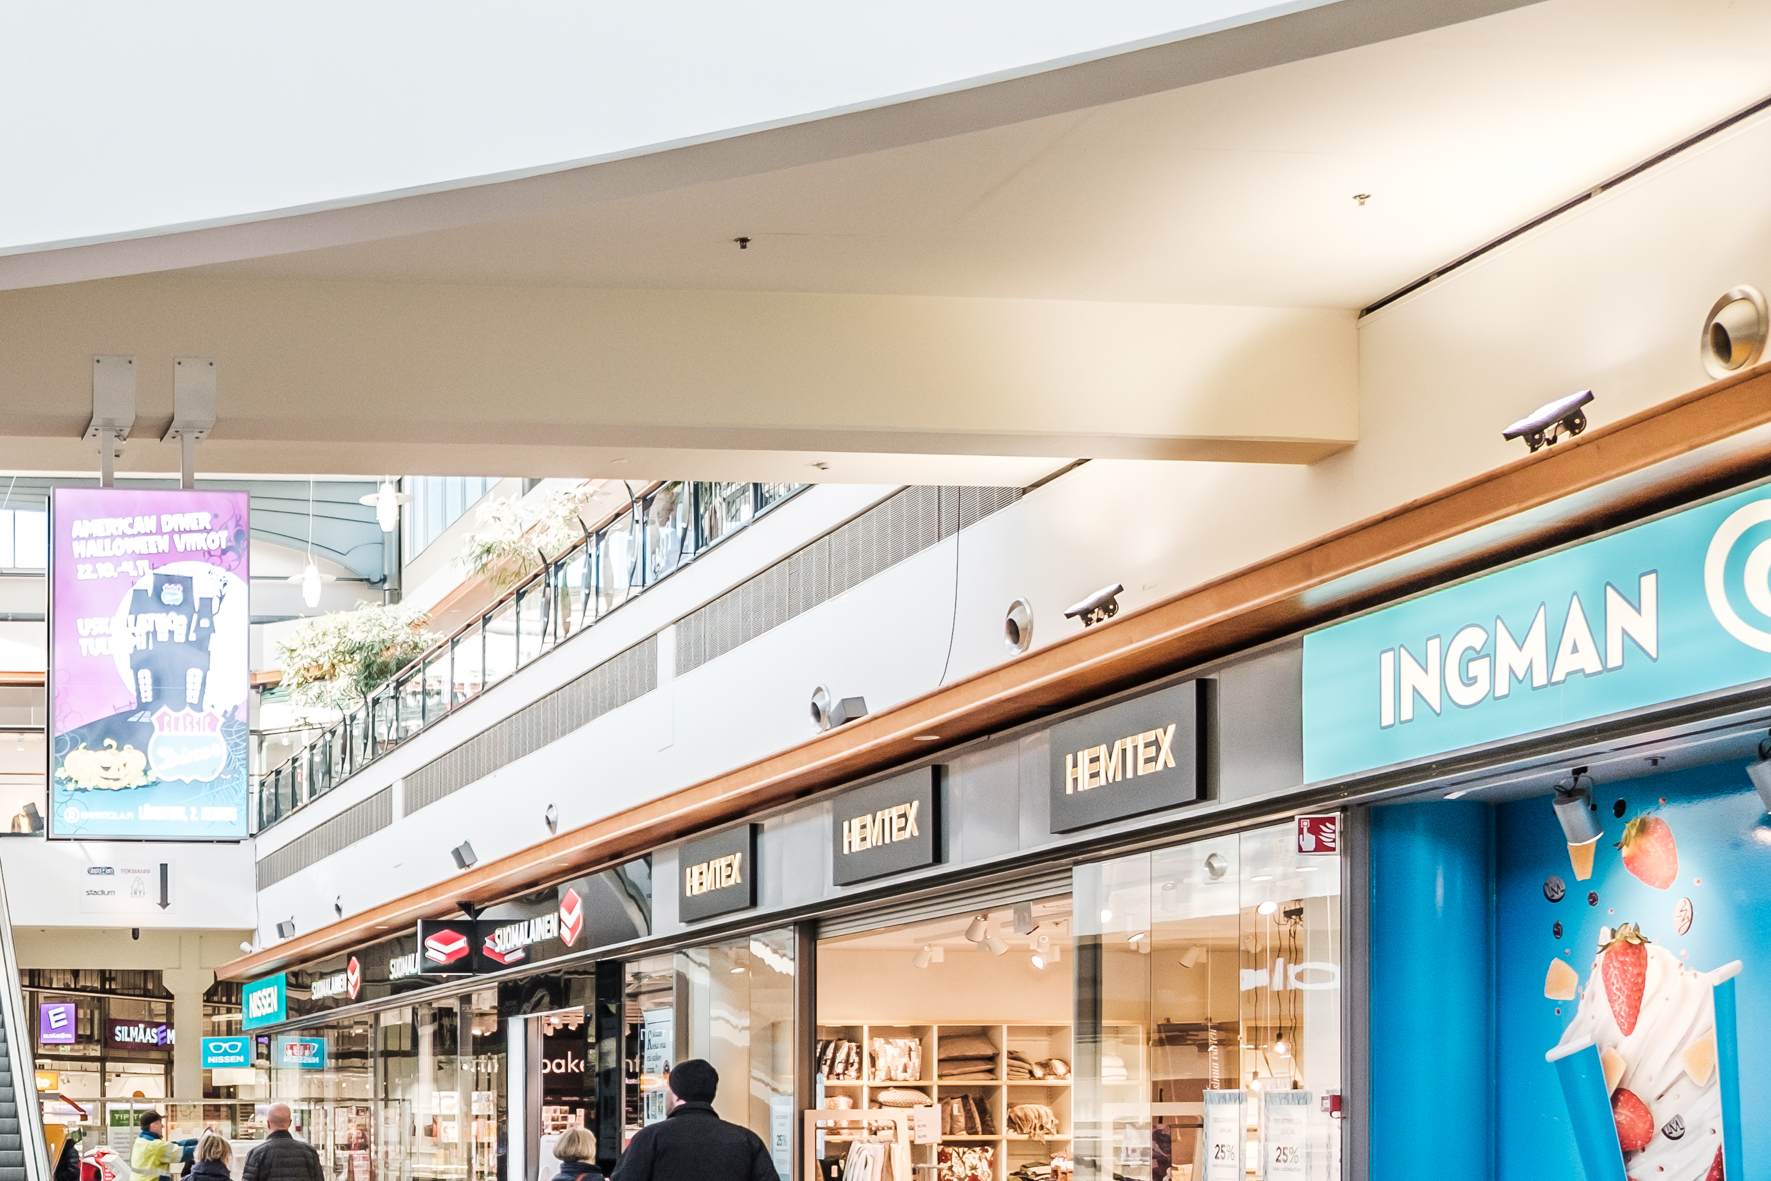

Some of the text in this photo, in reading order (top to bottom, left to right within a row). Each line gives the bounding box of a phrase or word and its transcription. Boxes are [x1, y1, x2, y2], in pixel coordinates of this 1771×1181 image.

[72, 512, 212, 538] AMERICAN DINER
[72, 530, 228, 559] HALLOWEEN VIIKOT
[1380, 568, 1659, 730] INGMAN
[157, 743, 222, 770] Diner
[1064, 723, 1176, 795] HEMTEX
[842, 800, 919, 855] HEMTEX
[685, 852, 742, 897] HEMTEX
[494, 912, 559, 953] SUOMALAINEN
[389, 952, 418, 980] SUOMALA
[249, 985, 278, 1018] NISSEN
[115, 1023, 175, 1046] SILMÄASEM
[208, 1055, 244, 1063] NISSEN
[1214, 1143, 1235, 1161] 25%
[1275, 1146, 1299, 1164] 25%
